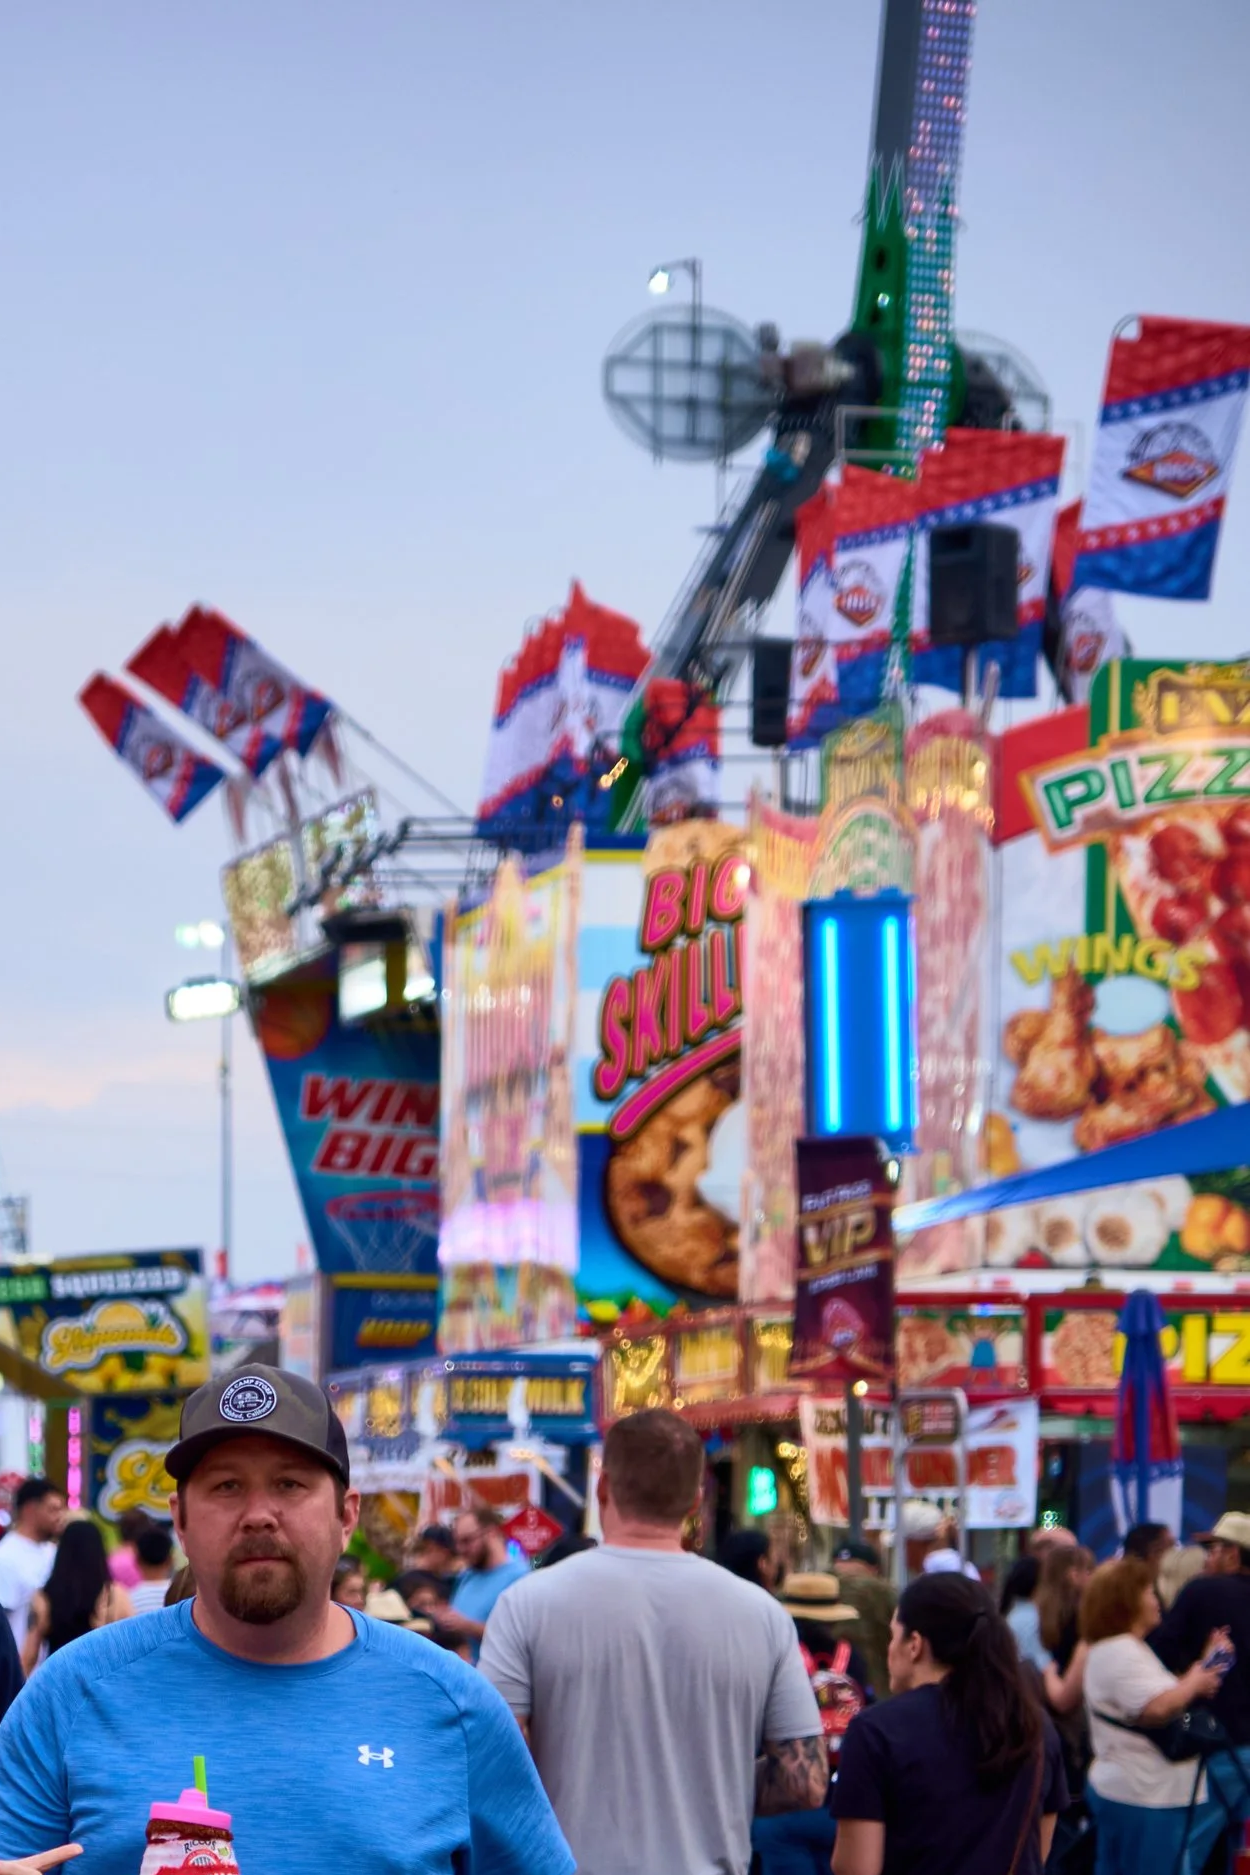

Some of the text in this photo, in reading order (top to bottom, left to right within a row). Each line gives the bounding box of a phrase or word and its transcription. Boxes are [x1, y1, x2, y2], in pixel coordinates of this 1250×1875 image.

[1043, 746, 1250, 829] PIZZ
[1010, 931, 1206, 992] WINGS
[301, 1073, 441, 1127] WIN
[312, 1128, 440, 1178] BIG
